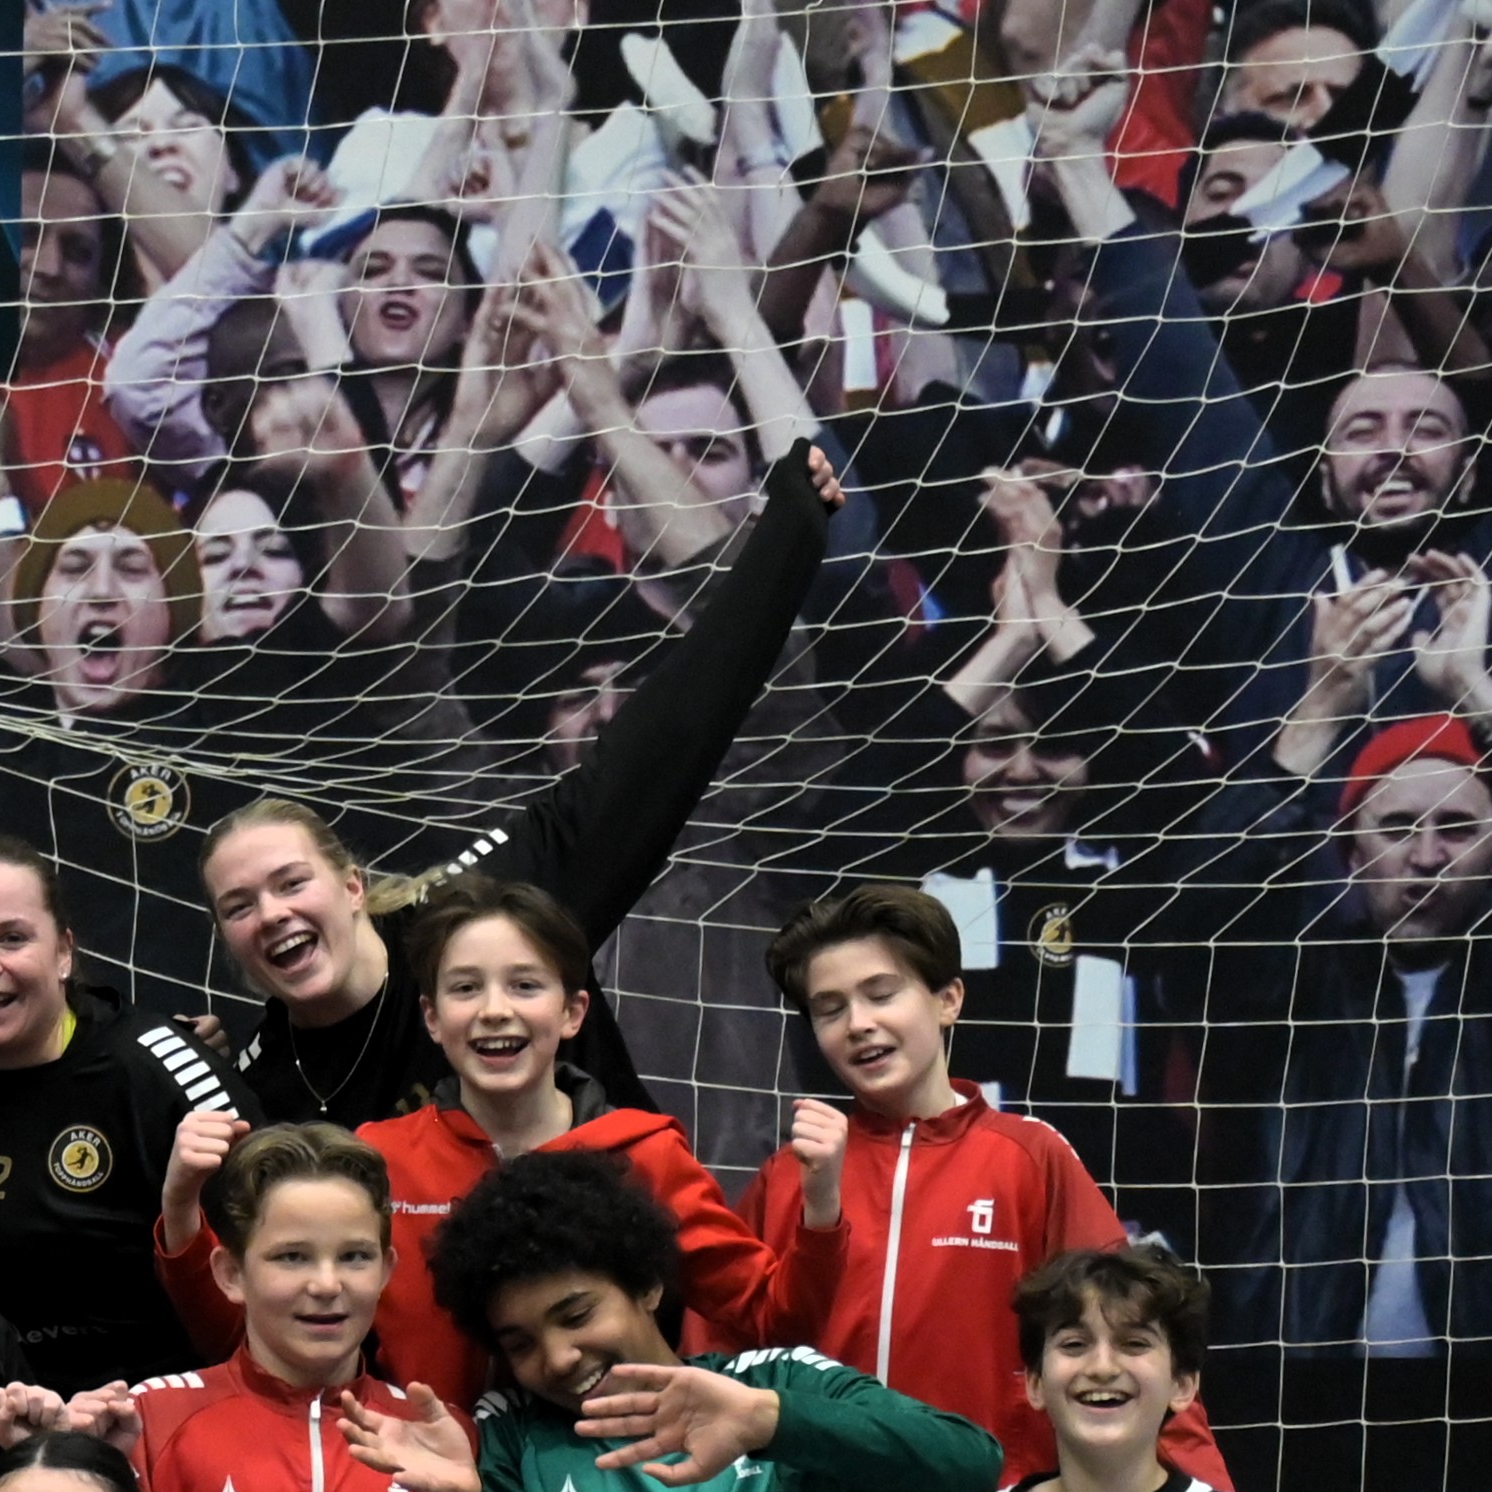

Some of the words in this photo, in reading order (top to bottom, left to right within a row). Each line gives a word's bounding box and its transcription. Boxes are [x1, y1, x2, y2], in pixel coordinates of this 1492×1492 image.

[70, 1131, 101, 1146] AKER
[932, 1237, 970, 1247] ULLERN
[971, 1236, 1019, 1252] HÅNDBALL
